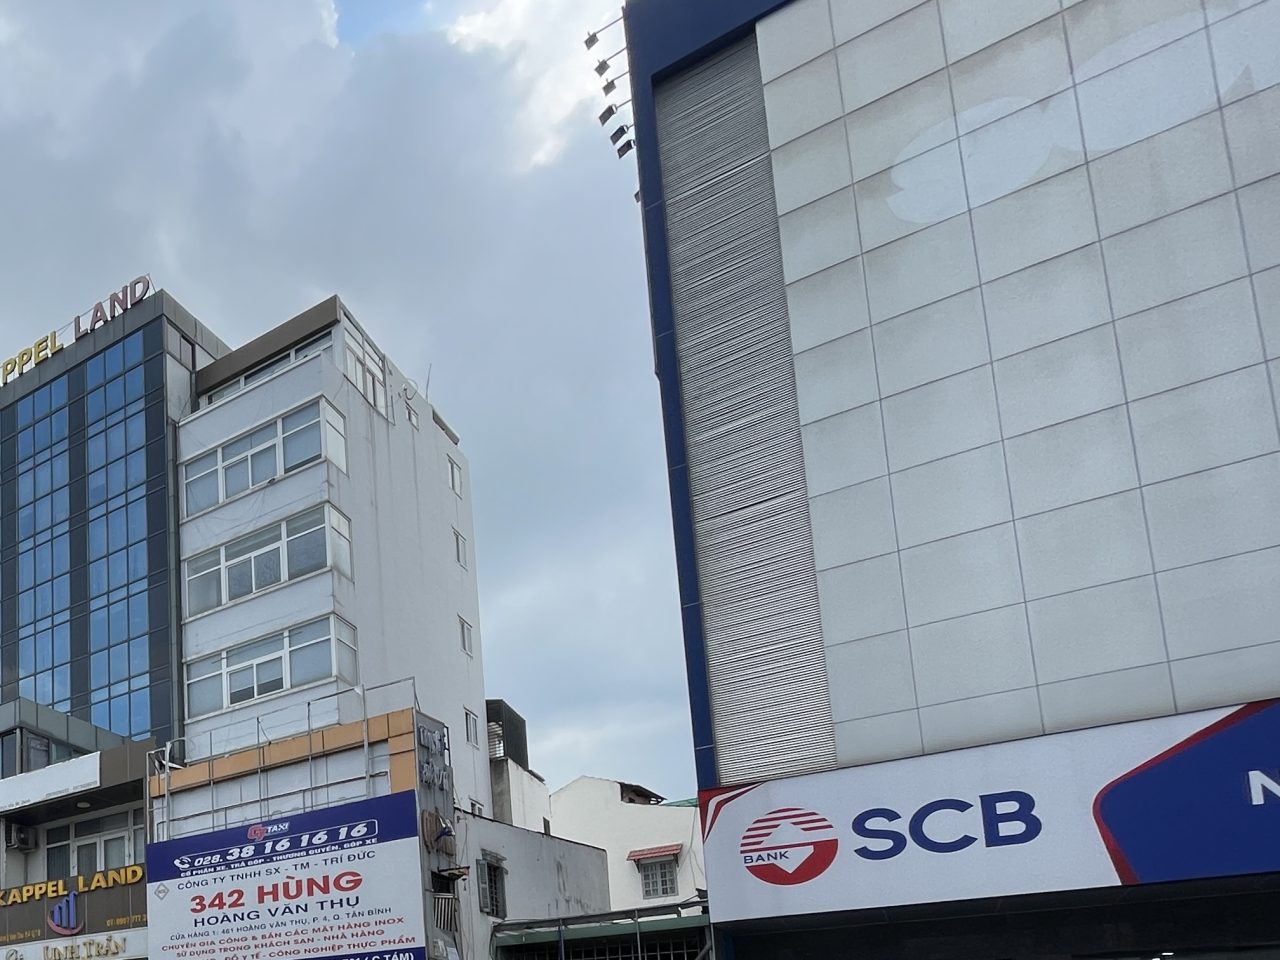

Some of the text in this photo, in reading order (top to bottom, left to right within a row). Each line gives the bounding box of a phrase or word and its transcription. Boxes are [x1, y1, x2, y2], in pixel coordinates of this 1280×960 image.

[74, 275, 150, 340] LAND
[267, 822, 290, 834] TAXI
[851, 790, 1043, 861] SCB
[194, 823, 368, 867] 028. 38 16 16 16
[743, 849, 789, 865] BANK
[78, 864, 145, 894] LAND
[177, 879, 209, 890] CÔNG
[212, 876, 225, 885] TY
[229, 871, 261, 881] TNHH
[265, 866, 280, 876] SX
[292, 862, 310, 871] TM
[322, 853, 343, 866] TRÍ
[347, 850, 376, 862] ĐỨC
[190, 870, 363, 914] 342 HÙNG
[188, 929, 210, 939] HÀNG
[236, 922, 267, 932] HOÀNG
[345, 911, 365, 919] TÂN
[367, 907, 392, 916] BÌNH
[194, 895, 360, 928] HOÀNG VĂN THỤ
[219, 936, 248, 945] CÔNG
[261, 930, 282, 940] BÁN
[284, 928, 309, 937] CÁC
[337, 920, 371, 931] HÀNG
[374, 917, 405, 927] INOX
[219, 944, 251, 953] TRONG
[254, 939, 291, 950] KHÁCH
[323, 932, 348, 942] NHÀ
[351, 929, 385, 939] HÀNG
[268, 948, 301, 958] CÔNG
